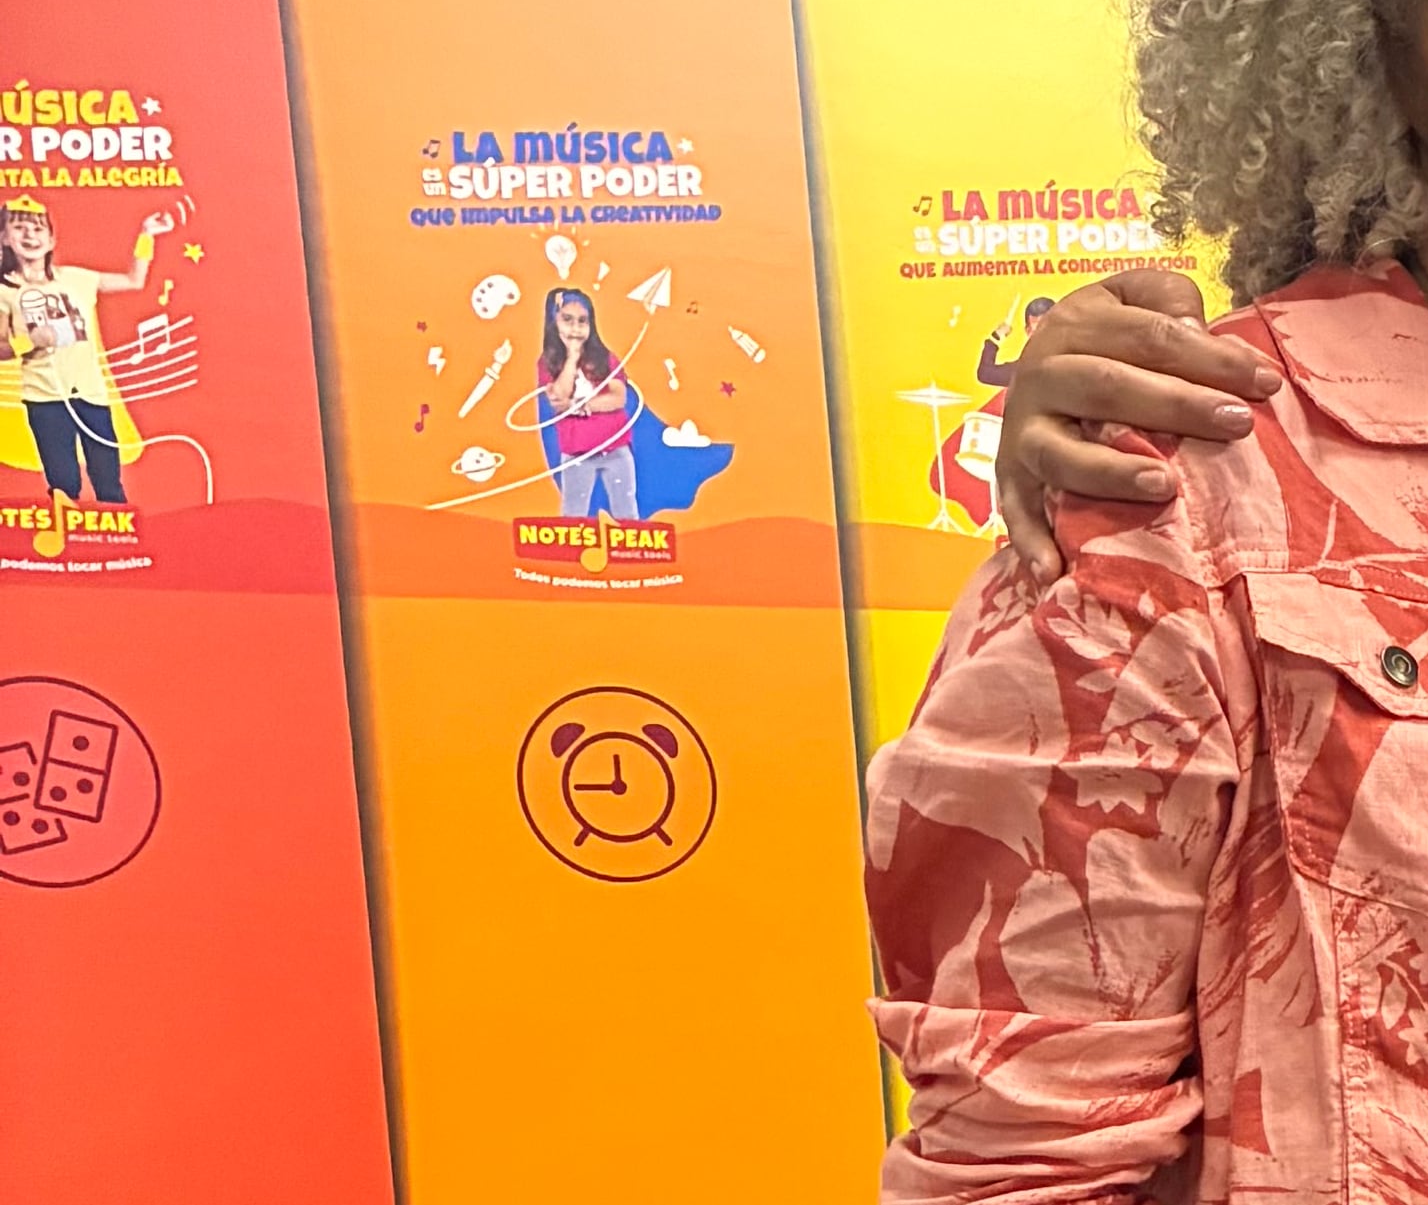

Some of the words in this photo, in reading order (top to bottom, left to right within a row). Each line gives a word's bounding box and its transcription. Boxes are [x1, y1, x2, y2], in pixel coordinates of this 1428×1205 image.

[0, 79, 140, 126] ÚSICA
[31, 126, 174, 162] PODER
[453, 131, 504, 164] LA
[514, 122, 674, 164] MÚSICA
[41, 167, 73, 187] LA
[77, 162, 183, 187] ALEGRÍA
[448, 157, 574, 200] SÚPER
[580, 164, 703, 199] PODER
[411, 208, 456, 226] QUE
[461, 206, 556, 226] IMPULSA
[561, 206, 586, 224] LA
[591, 204, 722, 224] CREATIVIDAD
[942, 190, 989, 222] LA
[998, 179, 1141, 221] MÚSICA
[938, 215, 1050, 257] SÚPER
[900, 262, 936, 280] QUE
[942, 260, 1031, 278] AUMENTA
[1033, 259, 1056, 275] LA
[0, 504, 52, 529] TE'S
[66, 510, 136, 533] PEAK
[519, 523, 597, 546] NOTE'S
[609, 528, 669, 549] PEAK
